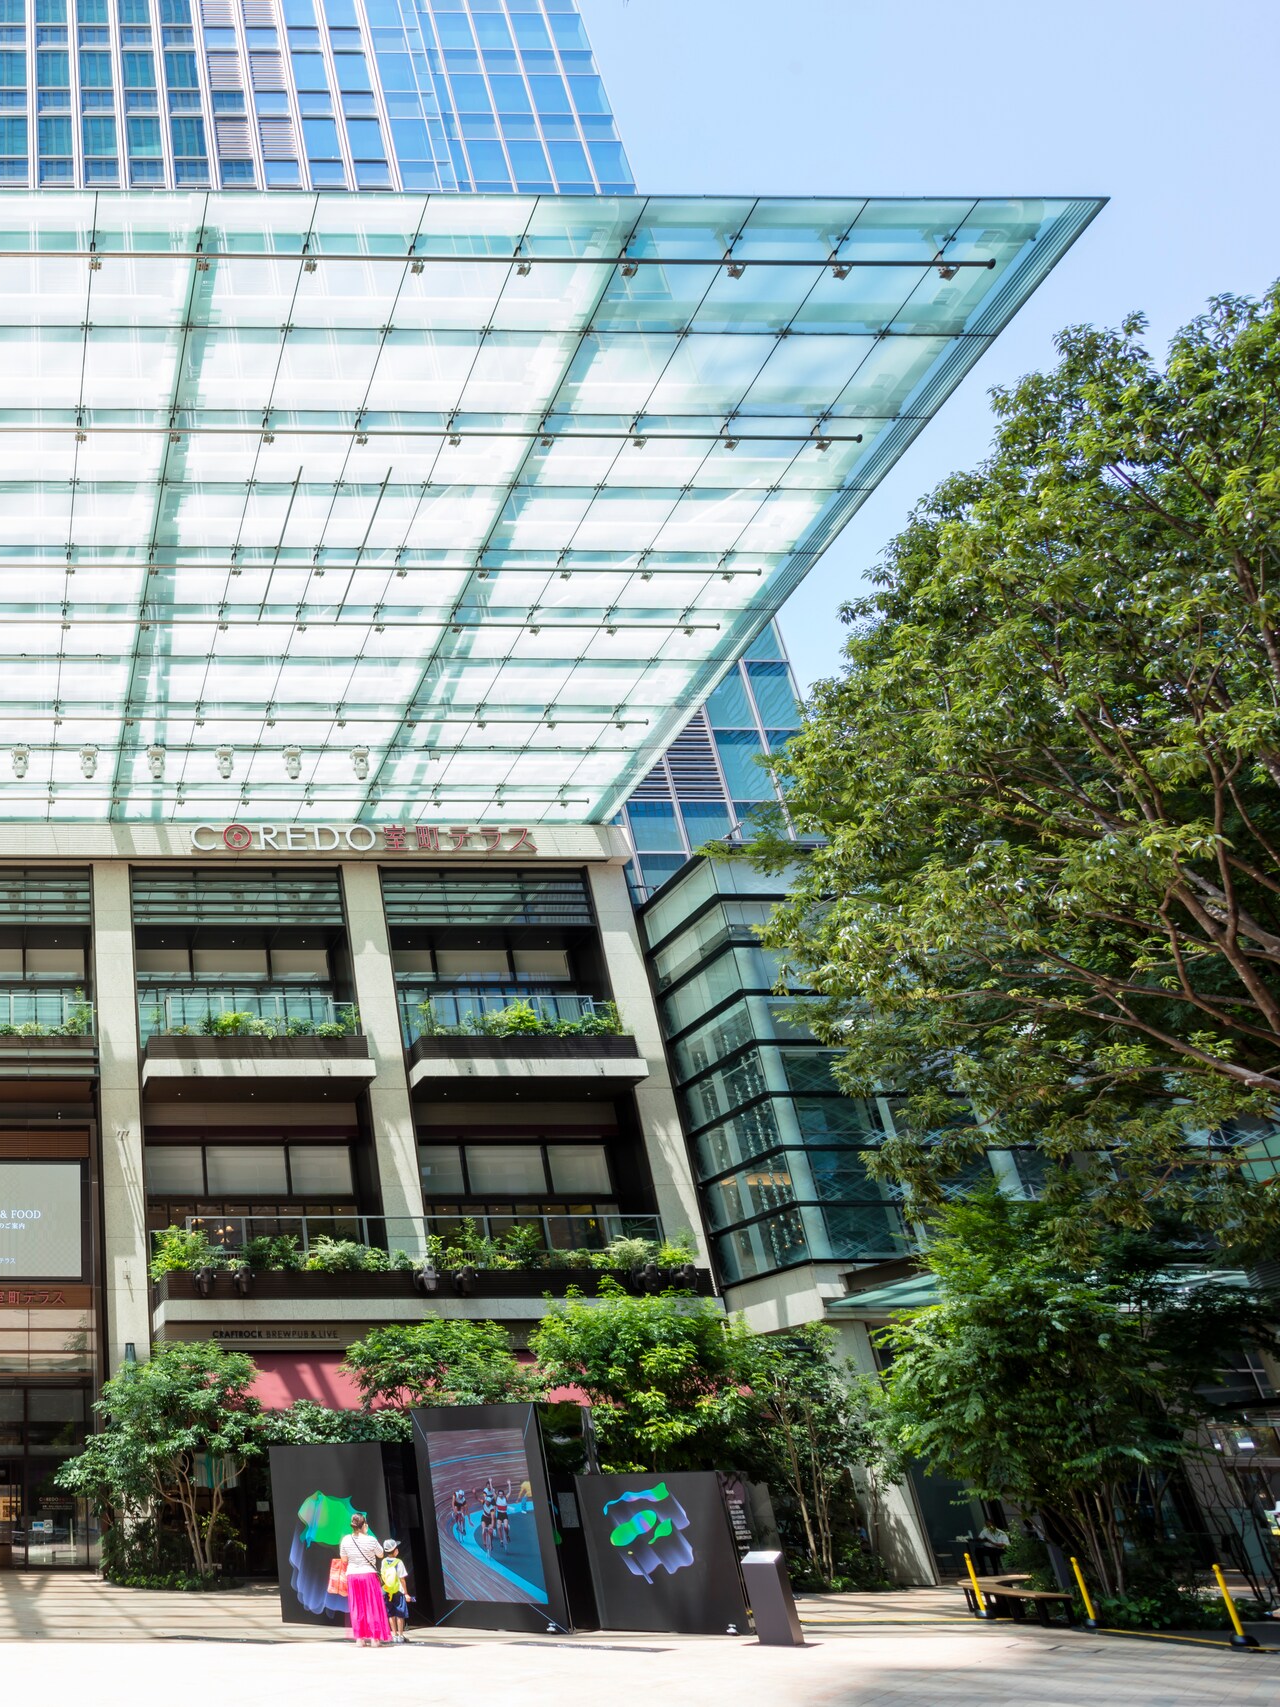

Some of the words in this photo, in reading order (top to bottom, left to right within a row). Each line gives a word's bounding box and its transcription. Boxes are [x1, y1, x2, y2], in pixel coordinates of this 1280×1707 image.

[0, 1210, 8, 1219] &
[11, 1210, 41, 1219] FOOD
[212, 1330, 262, 1338] CRAFTROCK
[266, 1330, 309, 1338] BREWPUB
[310, 1330, 317, 1338] &
[319, 1330, 338, 1338] LIVE
